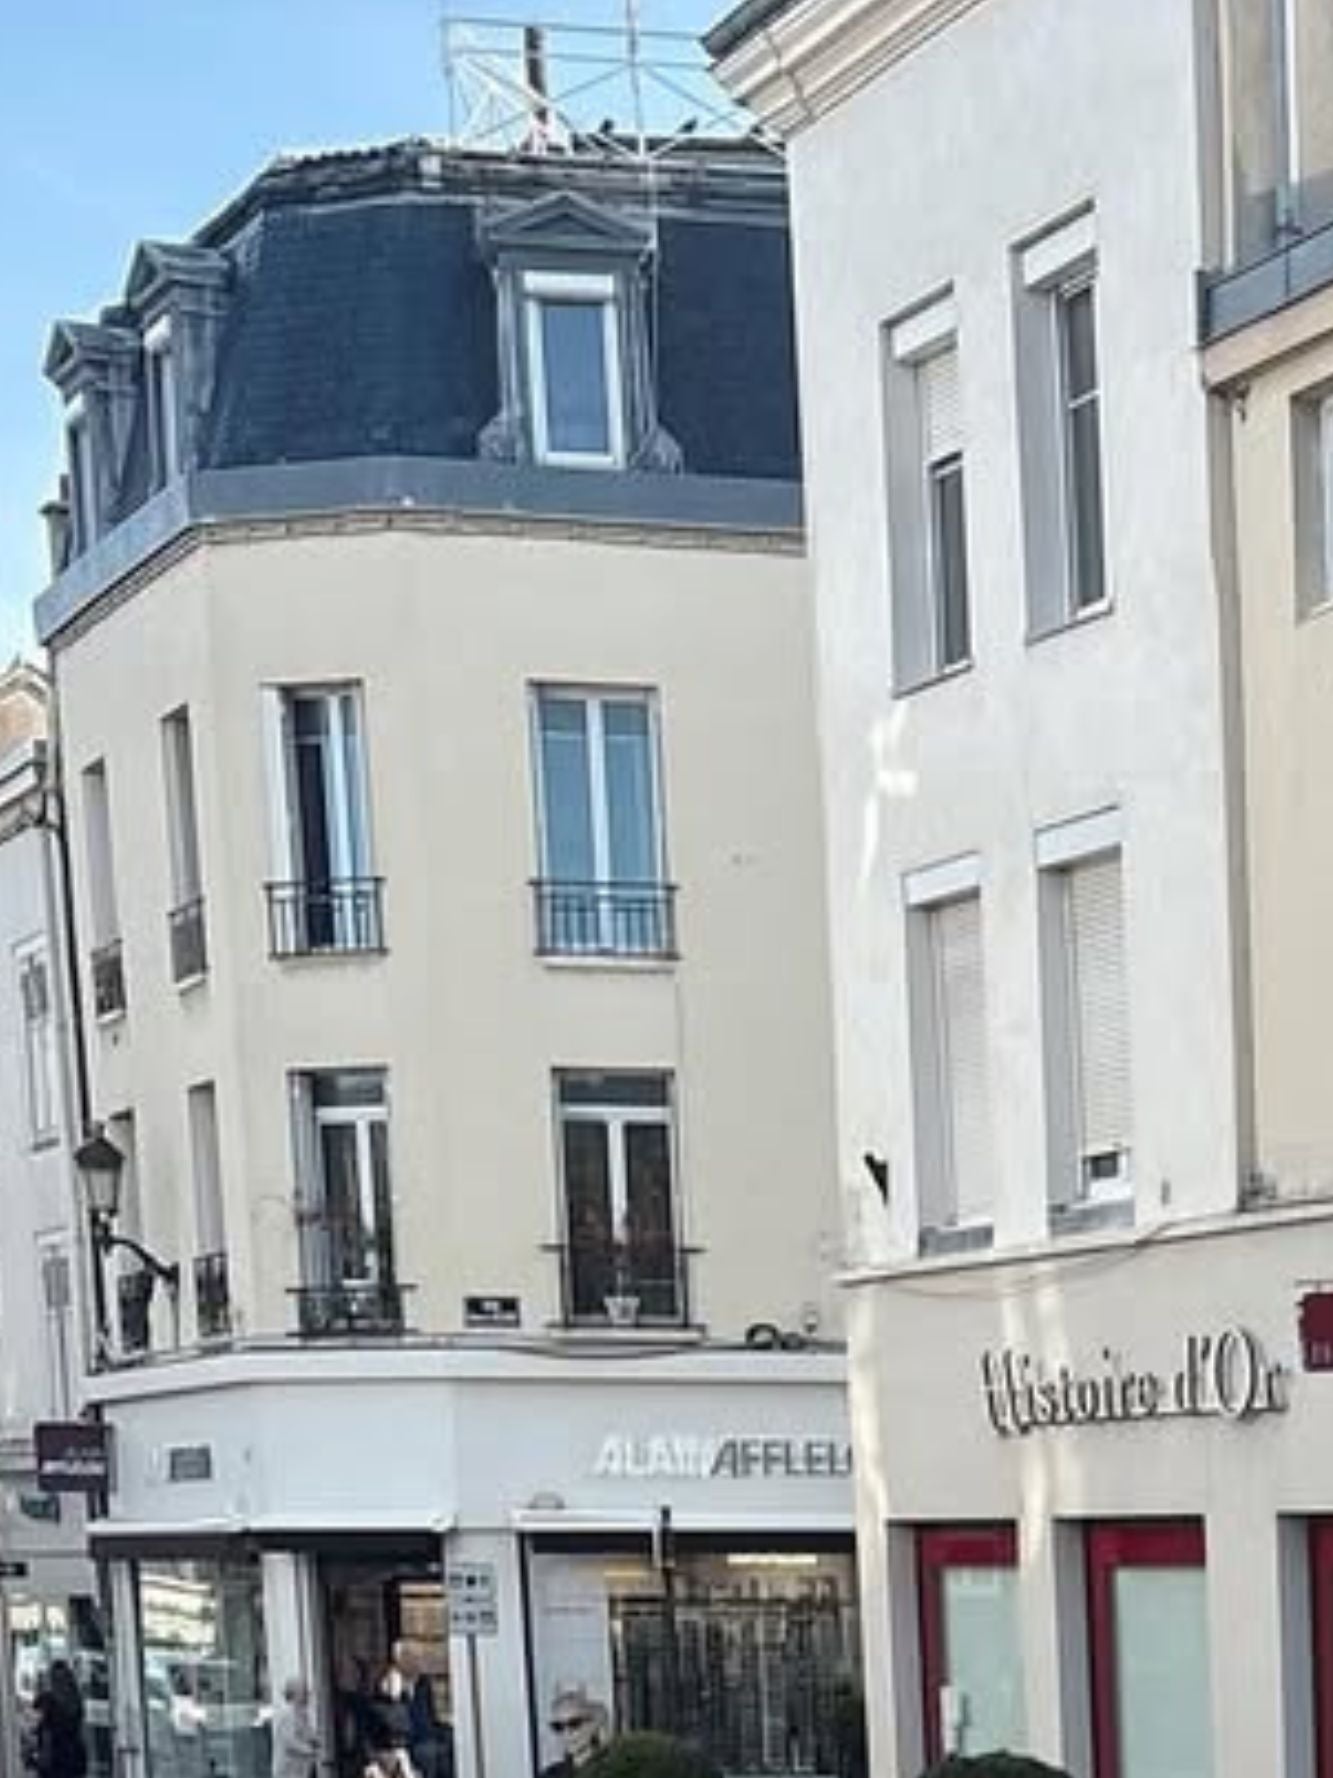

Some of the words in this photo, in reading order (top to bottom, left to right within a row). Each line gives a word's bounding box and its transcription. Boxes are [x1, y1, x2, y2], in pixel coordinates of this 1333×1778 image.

[979, 1345, 1167, 1435] Histoire
[1172, 1326, 1291, 1422] d'Or
[594, 1434, 711, 1477] ALAIN
